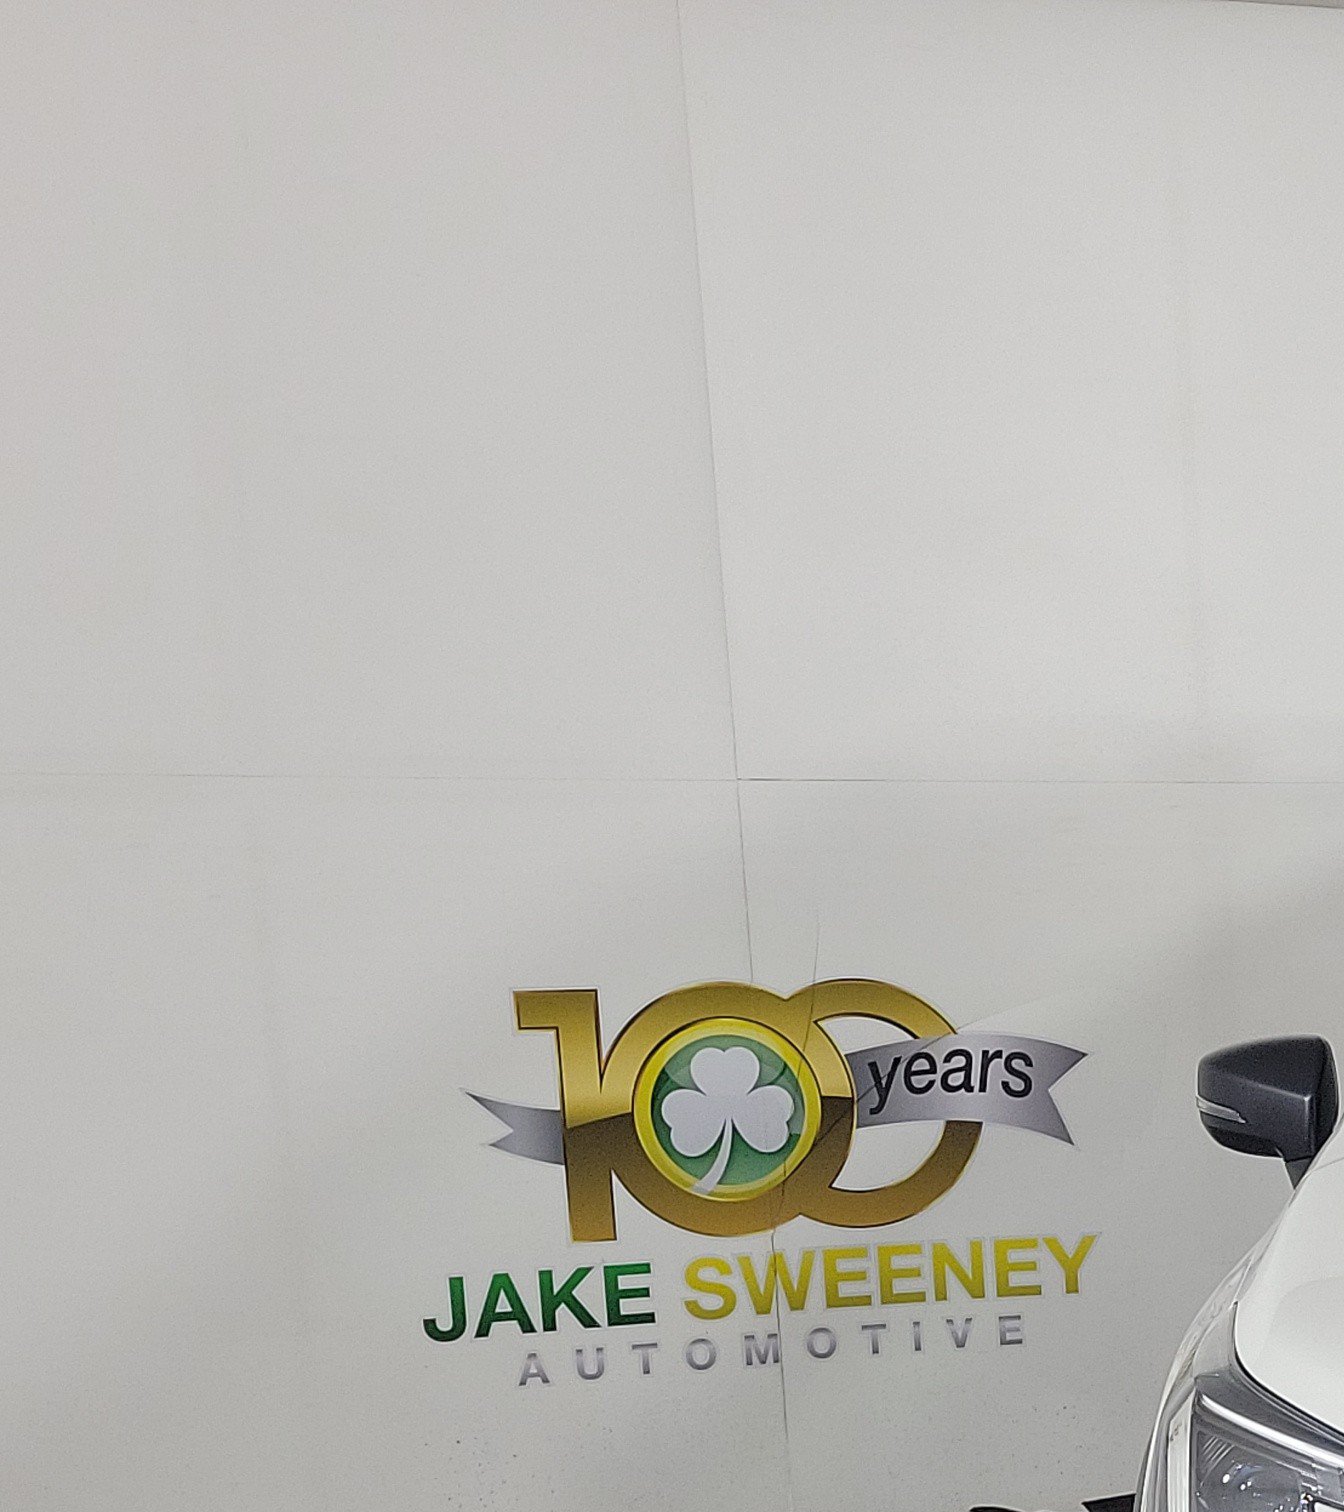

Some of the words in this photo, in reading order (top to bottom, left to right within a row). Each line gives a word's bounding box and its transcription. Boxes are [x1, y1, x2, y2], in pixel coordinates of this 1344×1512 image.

[513, 979, 983, 1243] 100
[866, 1046, 1035, 1115] years
[423, 1261, 656, 1342] JAKE
[683, 1234, 1098, 1321] SWEENEY
[518, 1314, 1025, 1387] AUTOMOTIVE
